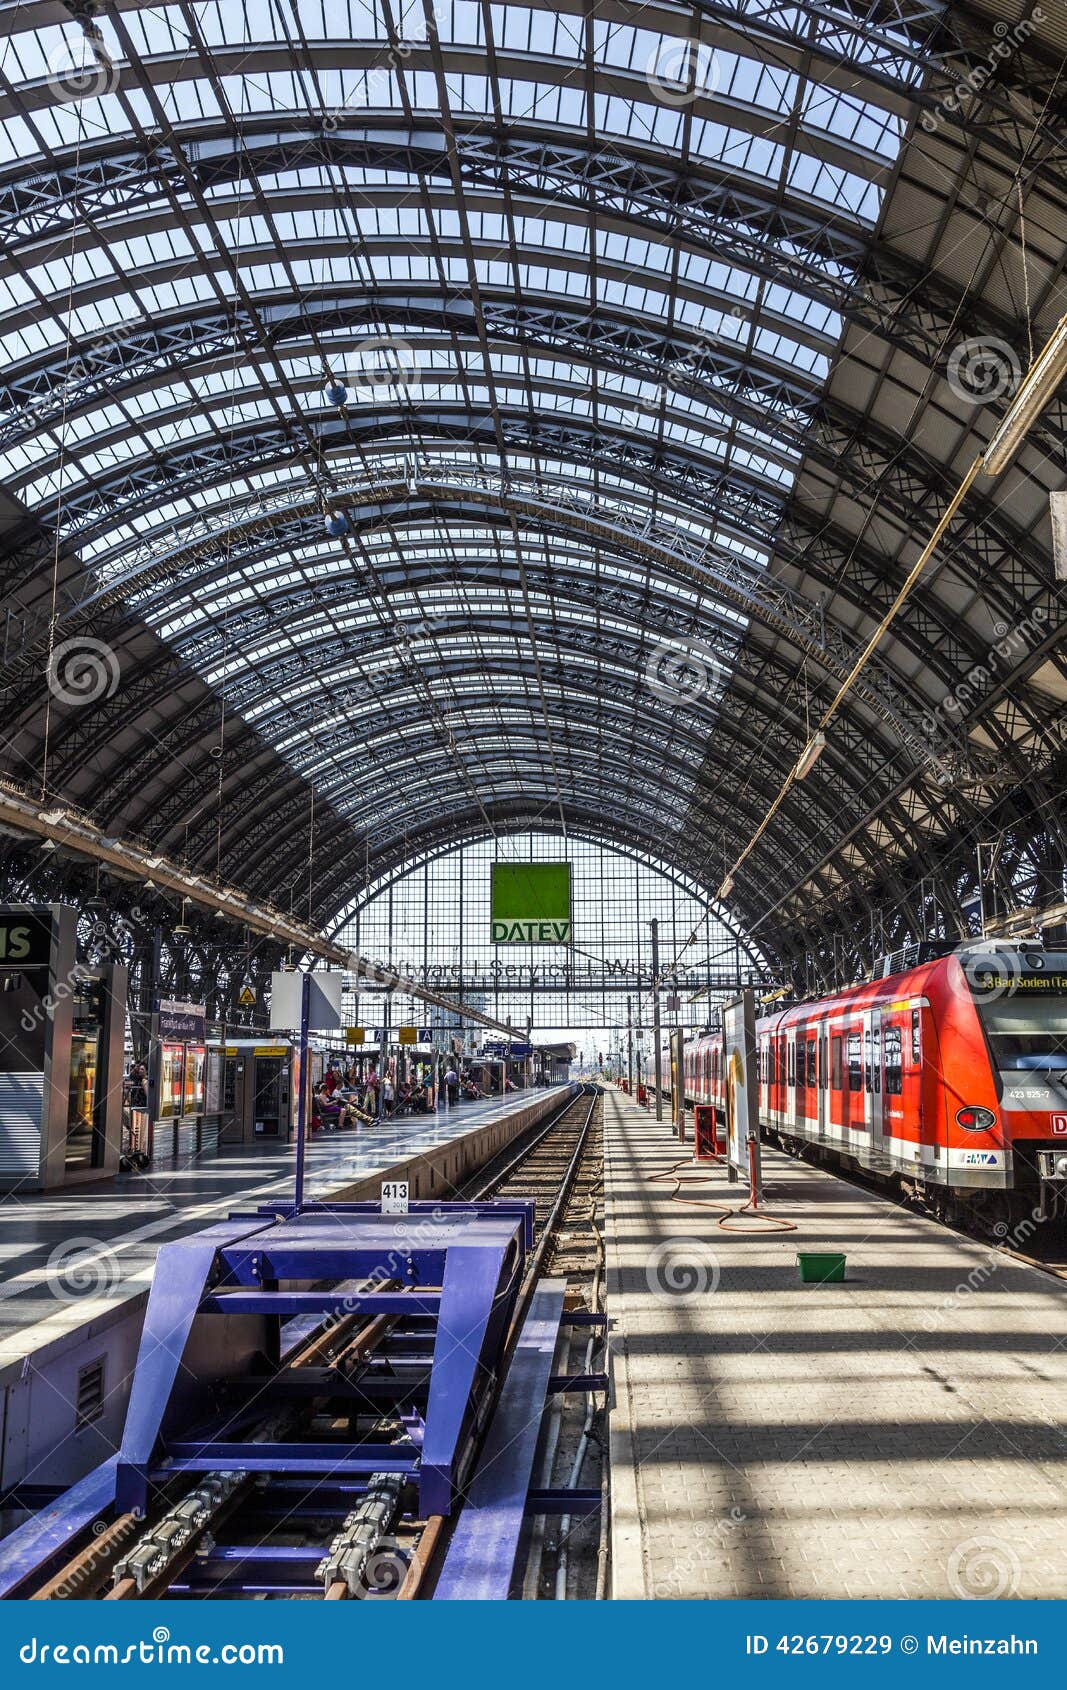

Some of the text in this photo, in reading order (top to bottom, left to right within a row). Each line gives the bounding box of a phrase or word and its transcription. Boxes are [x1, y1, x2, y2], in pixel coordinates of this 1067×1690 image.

[493, 922, 569, 942] DATEV
[490, 960, 572, 977] Service
[995, 977, 1014, 988] Bad
[423, 1031, 431, 1041] A
[383, 1184, 407, 1199] 413
